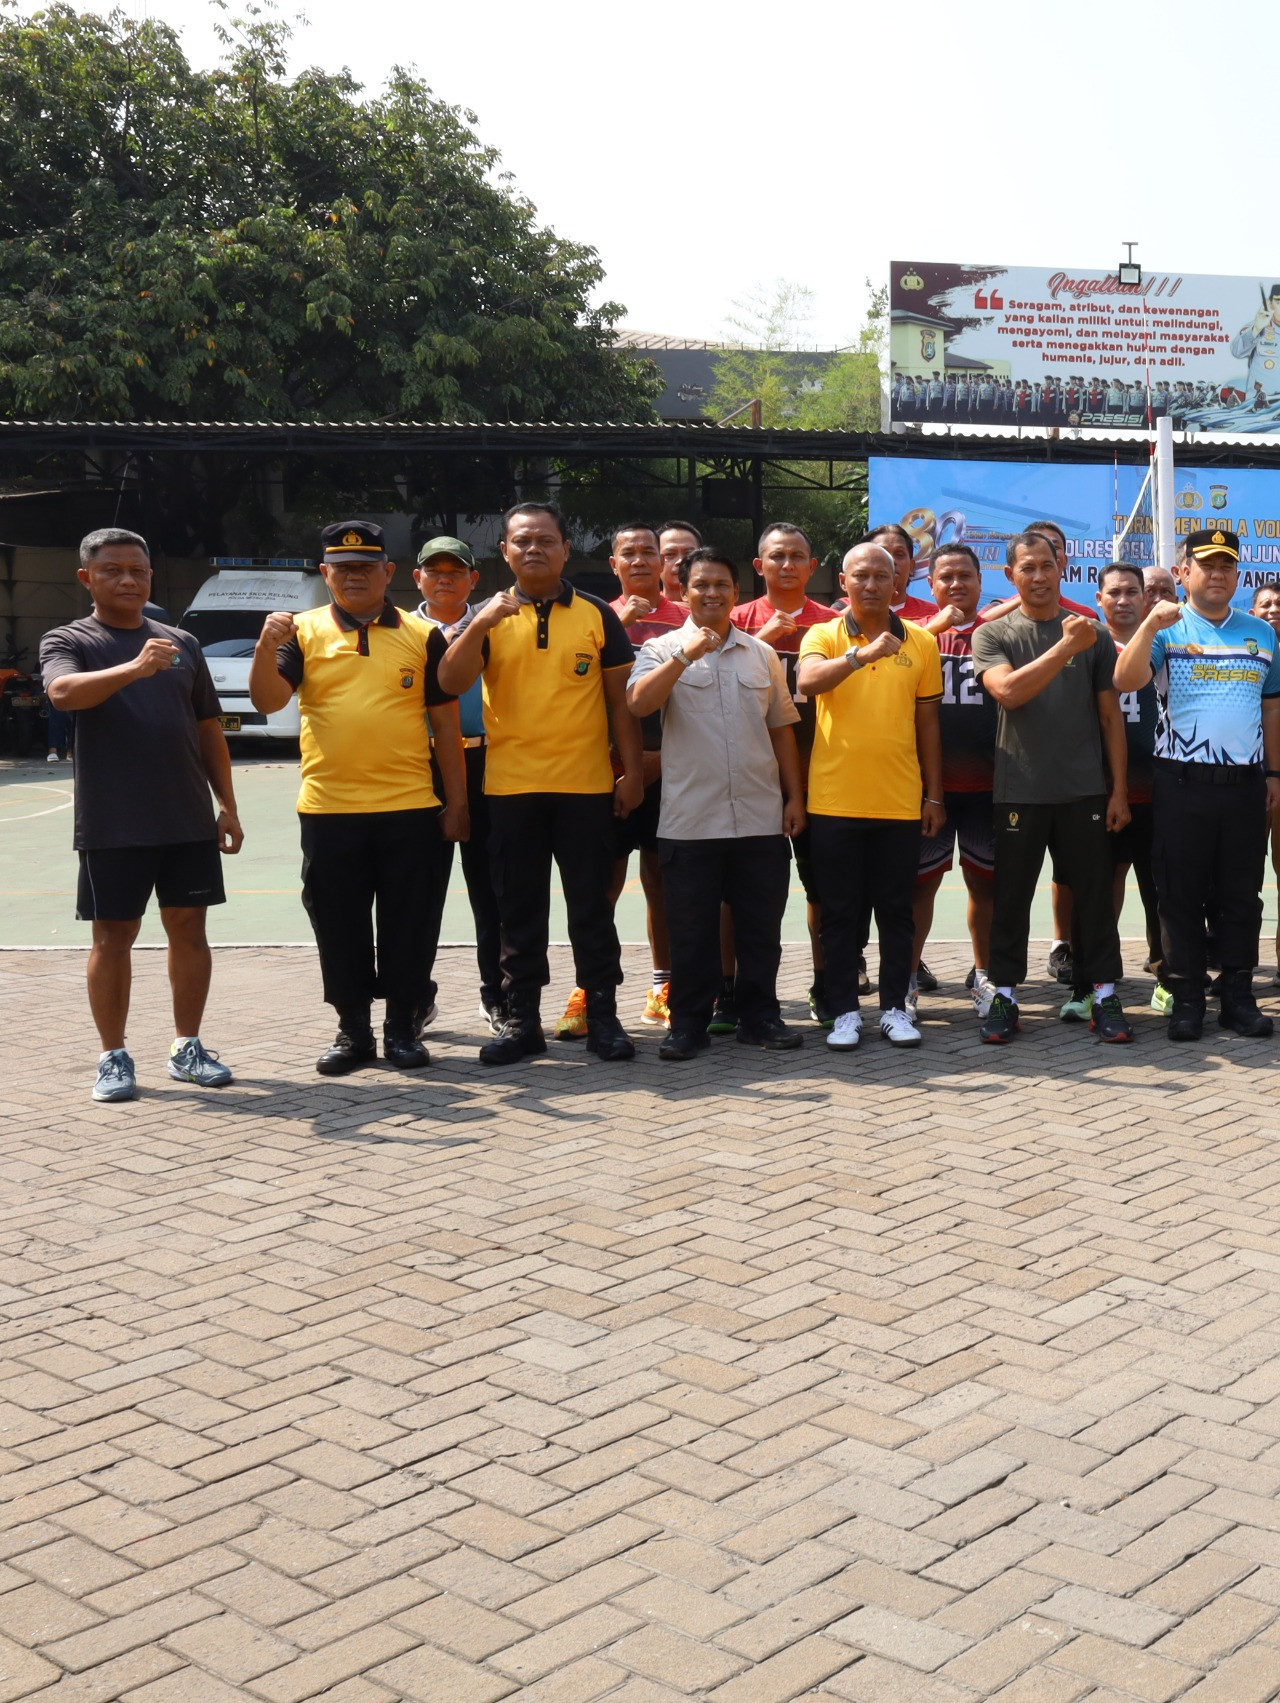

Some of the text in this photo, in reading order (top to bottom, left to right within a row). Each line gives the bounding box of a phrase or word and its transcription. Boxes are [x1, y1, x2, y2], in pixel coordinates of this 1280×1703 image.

[1008, 300, 1220, 318] Seragam, atribut, dan kewenangan
[1004, 314, 1223, 332] yang kalian miliki untuk melindungi,
[997, 326, 1230, 345] mengayomi, dan melayani masyarakat
[1012, 340, 1215, 356] serta menegakkan hukum dengan
[1042, 352, 1186, 367] humanis, jujur, dan adil.
[1080, 413, 1144, 424] PRESISI
[1112, 514, 1200, 534] TURNMEN
[1064, 539, 1114, 558] OLRES
[941, 660, 984, 706] 12
